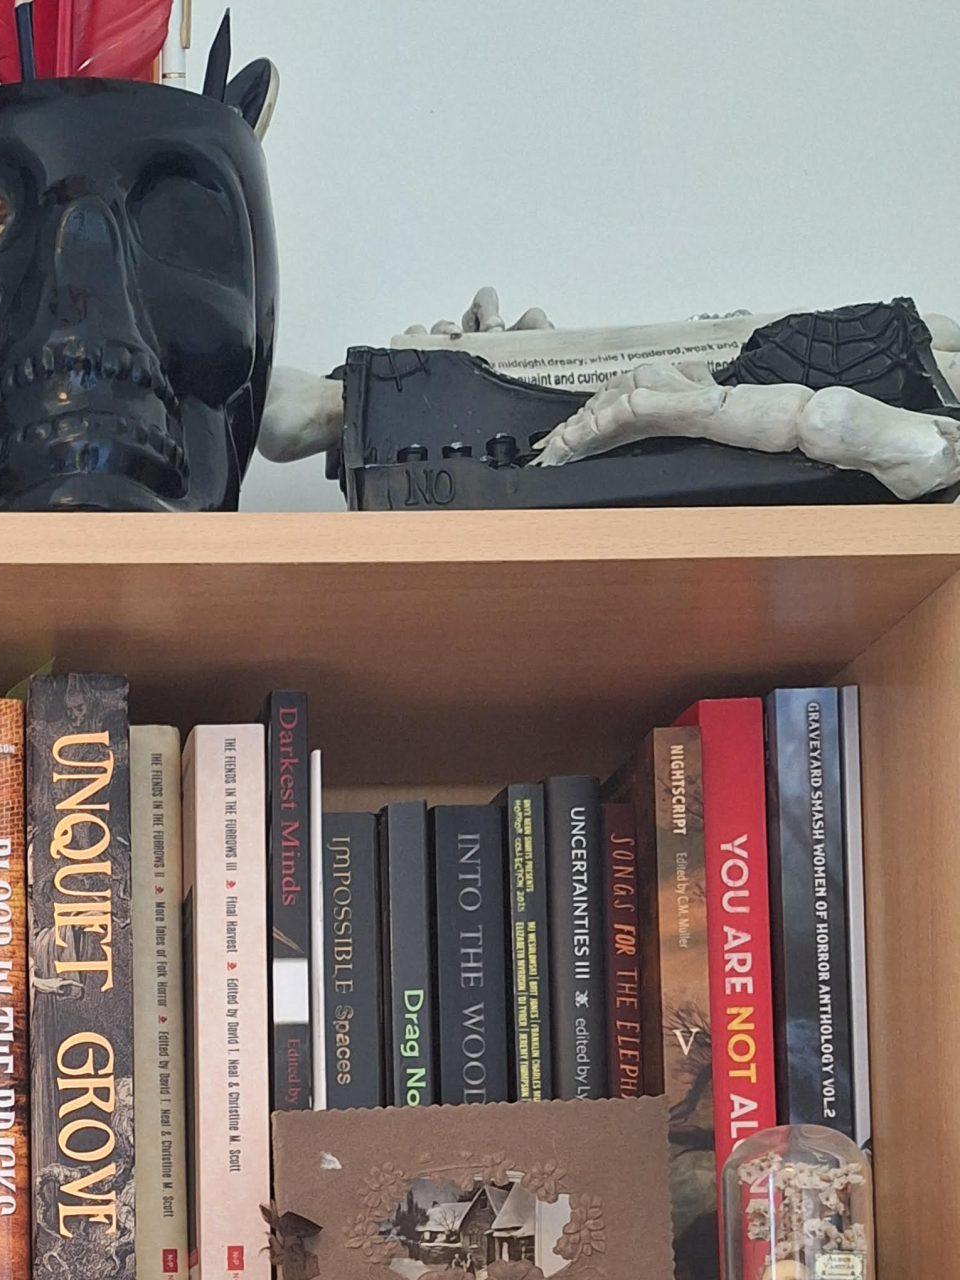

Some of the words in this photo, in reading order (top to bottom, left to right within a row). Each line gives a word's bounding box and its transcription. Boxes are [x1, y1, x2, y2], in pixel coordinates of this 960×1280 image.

[225, 755, 237, 785] FIENDS
[279, 706, 300, 811] Darkest
[807, 702, 823, 788] GRAVEYARD
[151, 769, 163, 798] FIENDS
[810, 790, 825, 840] SMASH
[50, 730, 114, 992] UNQUIET
[280, 821, 301, 907] Minds
[458, 833, 482, 912] INTO
[570, 807, 590, 956] UNCERTAINTIES
[610, 832, 636, 912] SONGS
[669, 744, 687, 836] NIGHTSCRIPT
[678, 918, 690, 949] Muller
[720, 833, 751, 915] YOU
[812, 843, 828, 897] WOMEN
[226, 920, 239, 953] Harvest
[326, 836, 354, 994] IMPOSSIBLE
[460, 924, 484, 988] THE
[722, 925, 754, 995] ARE
[815, 923, 831, 981] HORROR
[616, 968, 639, 1007] THE
[332, 1005, 355, 1086] Spaces
[400, 988, 425, 1058] Drag
[575, 1018, 590, 1063] edited
[725, 1005, 757, 1083] NOT
[819, 983, 835, 1074] ANTHOLOGY
[286, 1038, 301, 1084] Edited
[56, 1031, 117, 1238] GROVE
[228, 1091, 241, 1131] Christine
[161, 1139, 174, 1179] Christine
[229, 1149, 242, 1173] Scott
[162, 1195, 174, 1218] Scott
